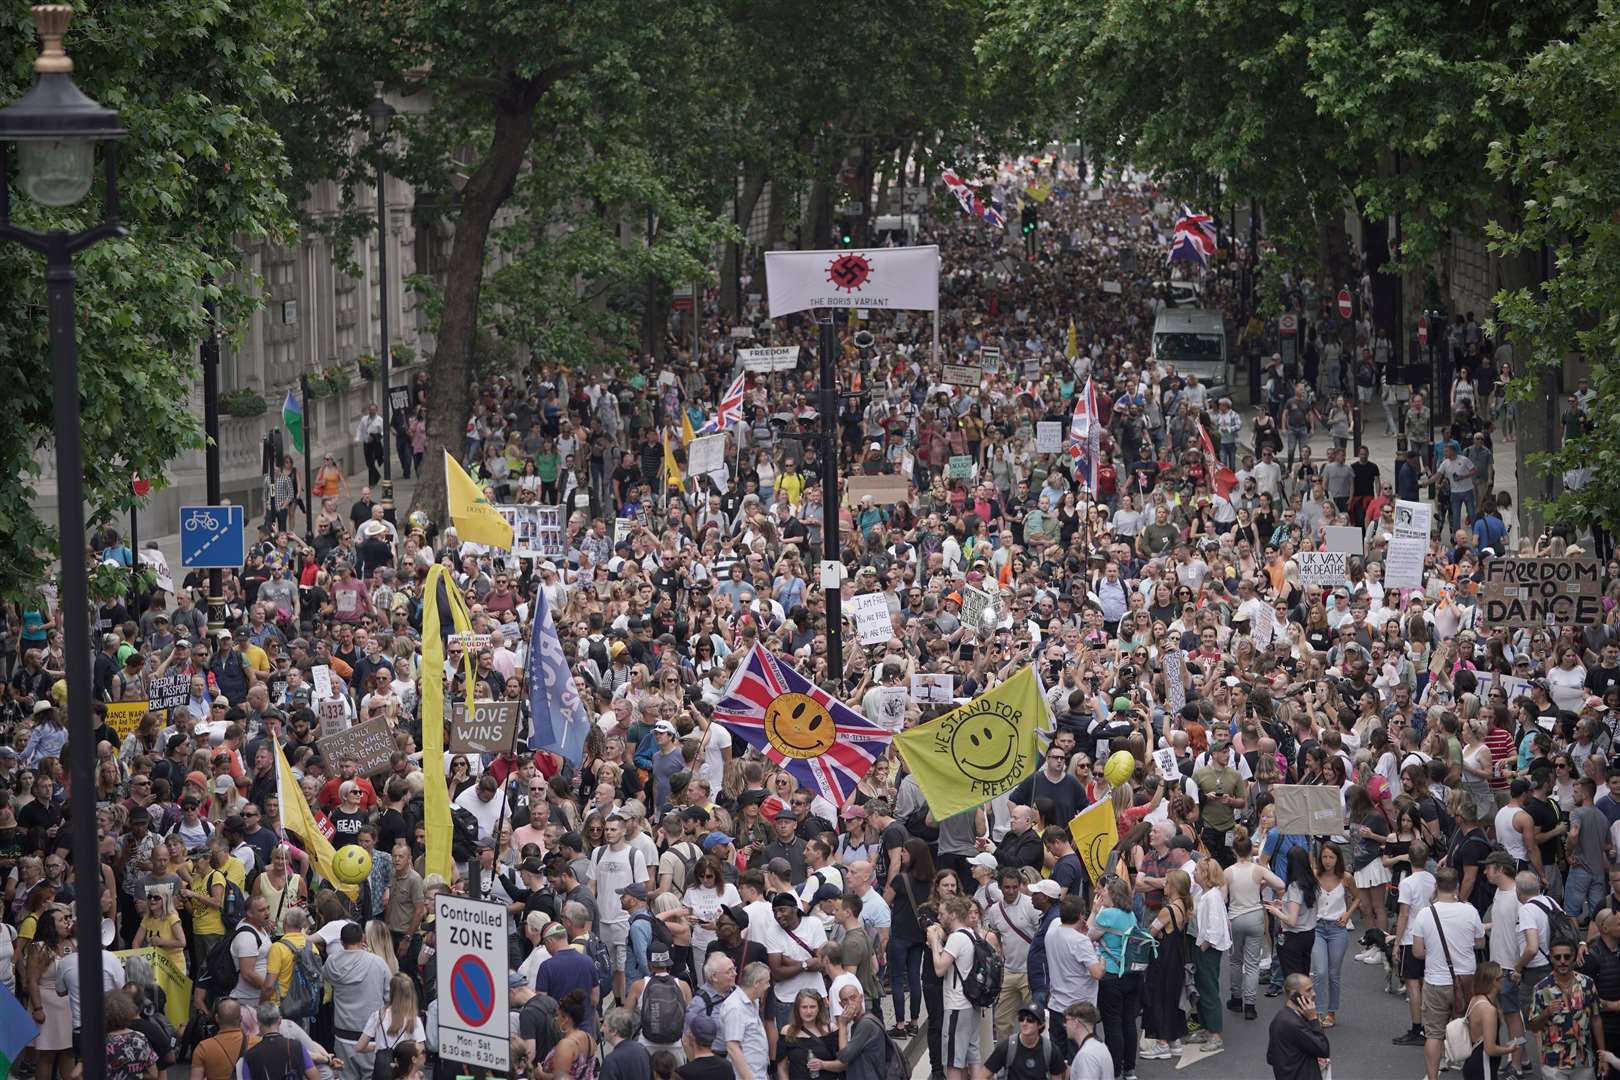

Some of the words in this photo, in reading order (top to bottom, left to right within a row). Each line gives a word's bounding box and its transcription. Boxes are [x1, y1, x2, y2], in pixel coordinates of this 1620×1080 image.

[810, 297, 825, 306] THE
[827, 297, 851, 306] BORIS
[855, 297, 889, 306] VARIANT
[749, 348, 790, 356] FREEDOM
[1302, 553, 1316, 565] UK
[1320, 553, 1344, 565] VAX
[1487, 595, 1600, 624] DANCE
[150, 675, 175, 689] FREEDOM
[176, 672, 192, 684] FROM
[162, 683, 191, 698] PASSPORT
[149, 693, 188, 711] ENSLAVEMENT
[106, 711, 127, 719] VANCE
[465, 707, 509, 724] LOVE
[995, 701, 1023, 725] FOR
[358, 729, 389, 748] WHEN
[457, 725, 503, 741] WINS
[324, 737, 347, 752] THIS
[970, 753, 1028, 797] FREEDOM
[440, 903, 502, 928] Controlled
[449, 925, 493, 950] ZONE
[456, 1034, 473, 1047] Mon
[478, 1038, 491, 1051] Sat
